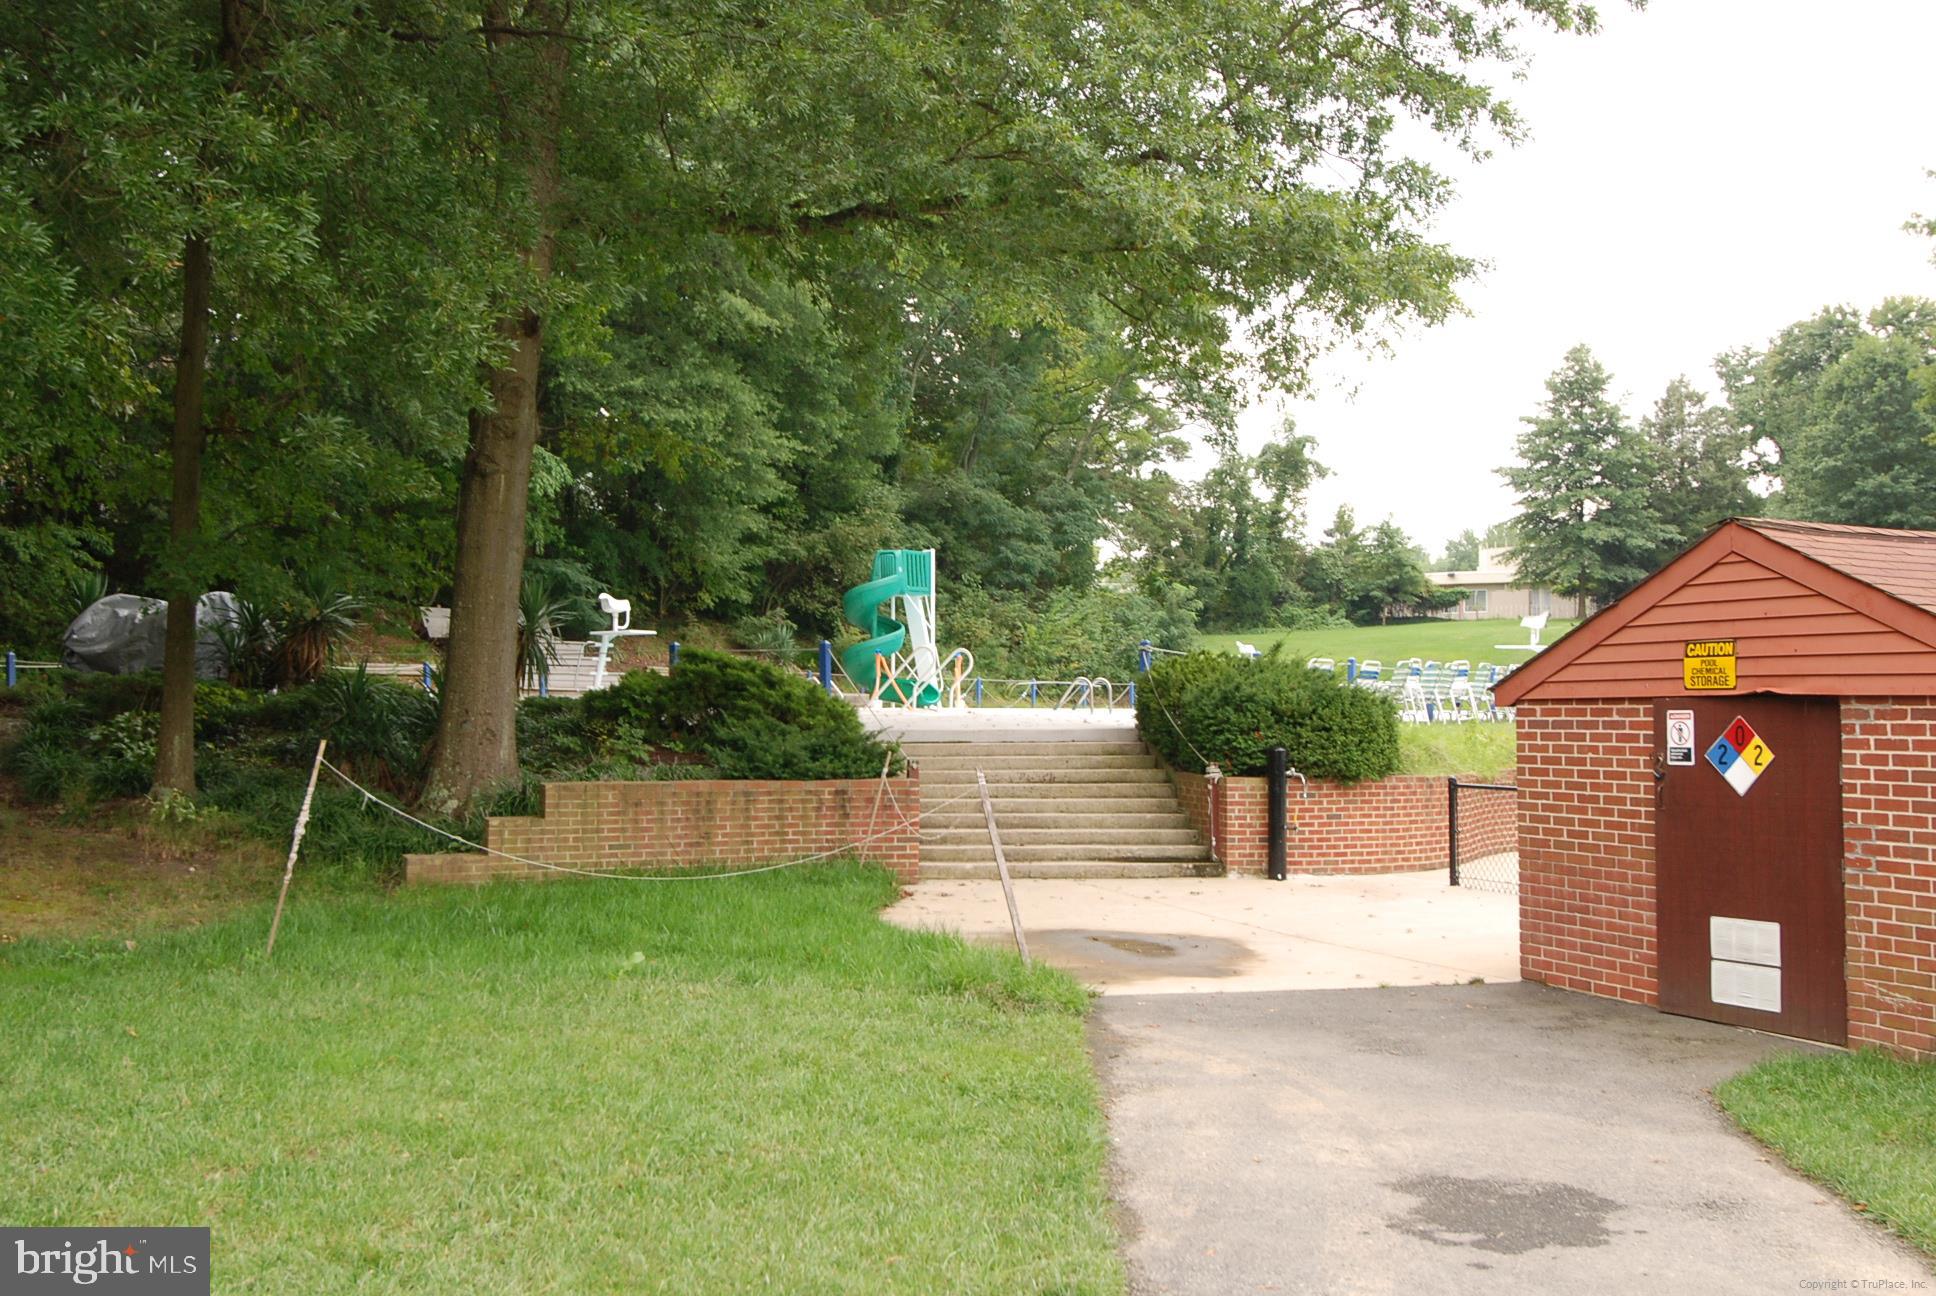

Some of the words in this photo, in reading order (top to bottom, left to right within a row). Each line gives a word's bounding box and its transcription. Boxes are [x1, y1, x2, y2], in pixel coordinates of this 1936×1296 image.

[1687, 642, 1733, 656] CAUTION
[1691, 667, 1727, 675] CHEMICAL
[1690, 675, 1729, 686] STORAGE
[1735, 725, 1745, 746] 0
[1718, 744, 1728, 765] 2
[1754, 745, 1763, 766] 2
